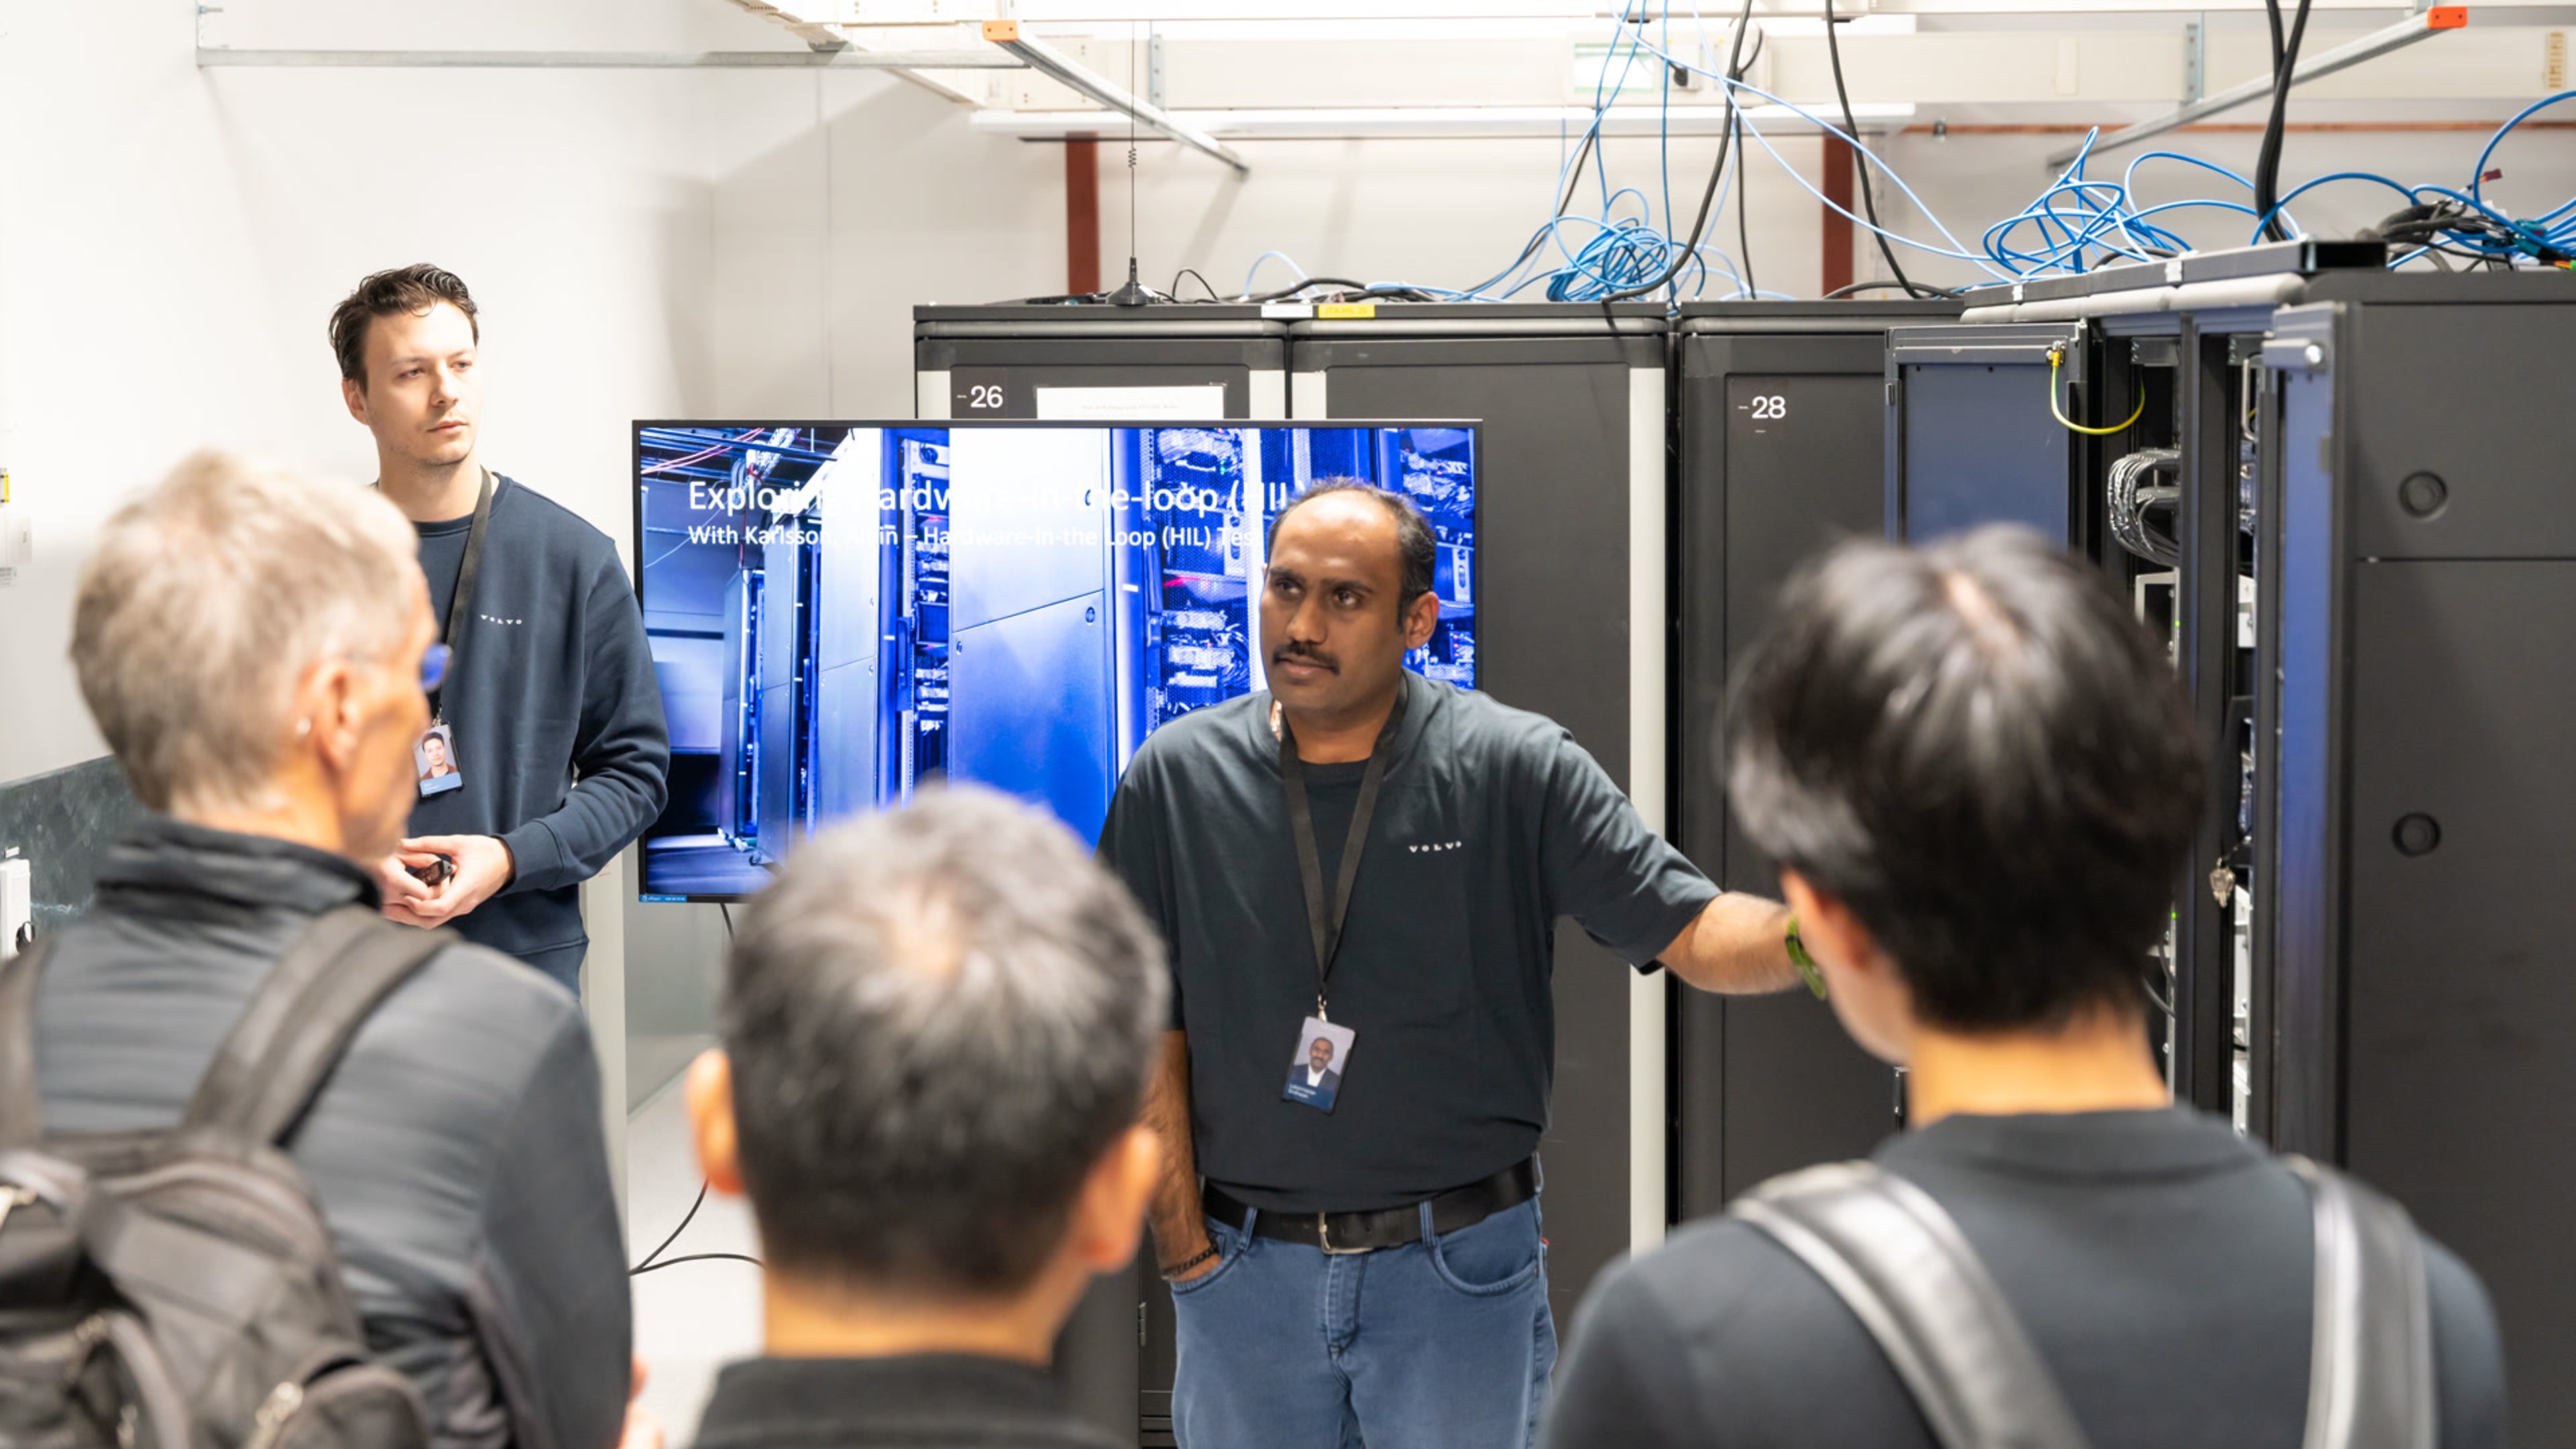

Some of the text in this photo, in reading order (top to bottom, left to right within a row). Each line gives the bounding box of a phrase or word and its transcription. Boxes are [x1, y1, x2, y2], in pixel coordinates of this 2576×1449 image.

[689, 480, 839, 517] Explori
[688, 525, 738, 545] With
[1104, 527, 1156, 550] Loop
[1162, 525, 1211, 550] (HIL)
[480, 614, 523, 625] VOLVO
[1409, 841, 1462, 853] VOLVO
